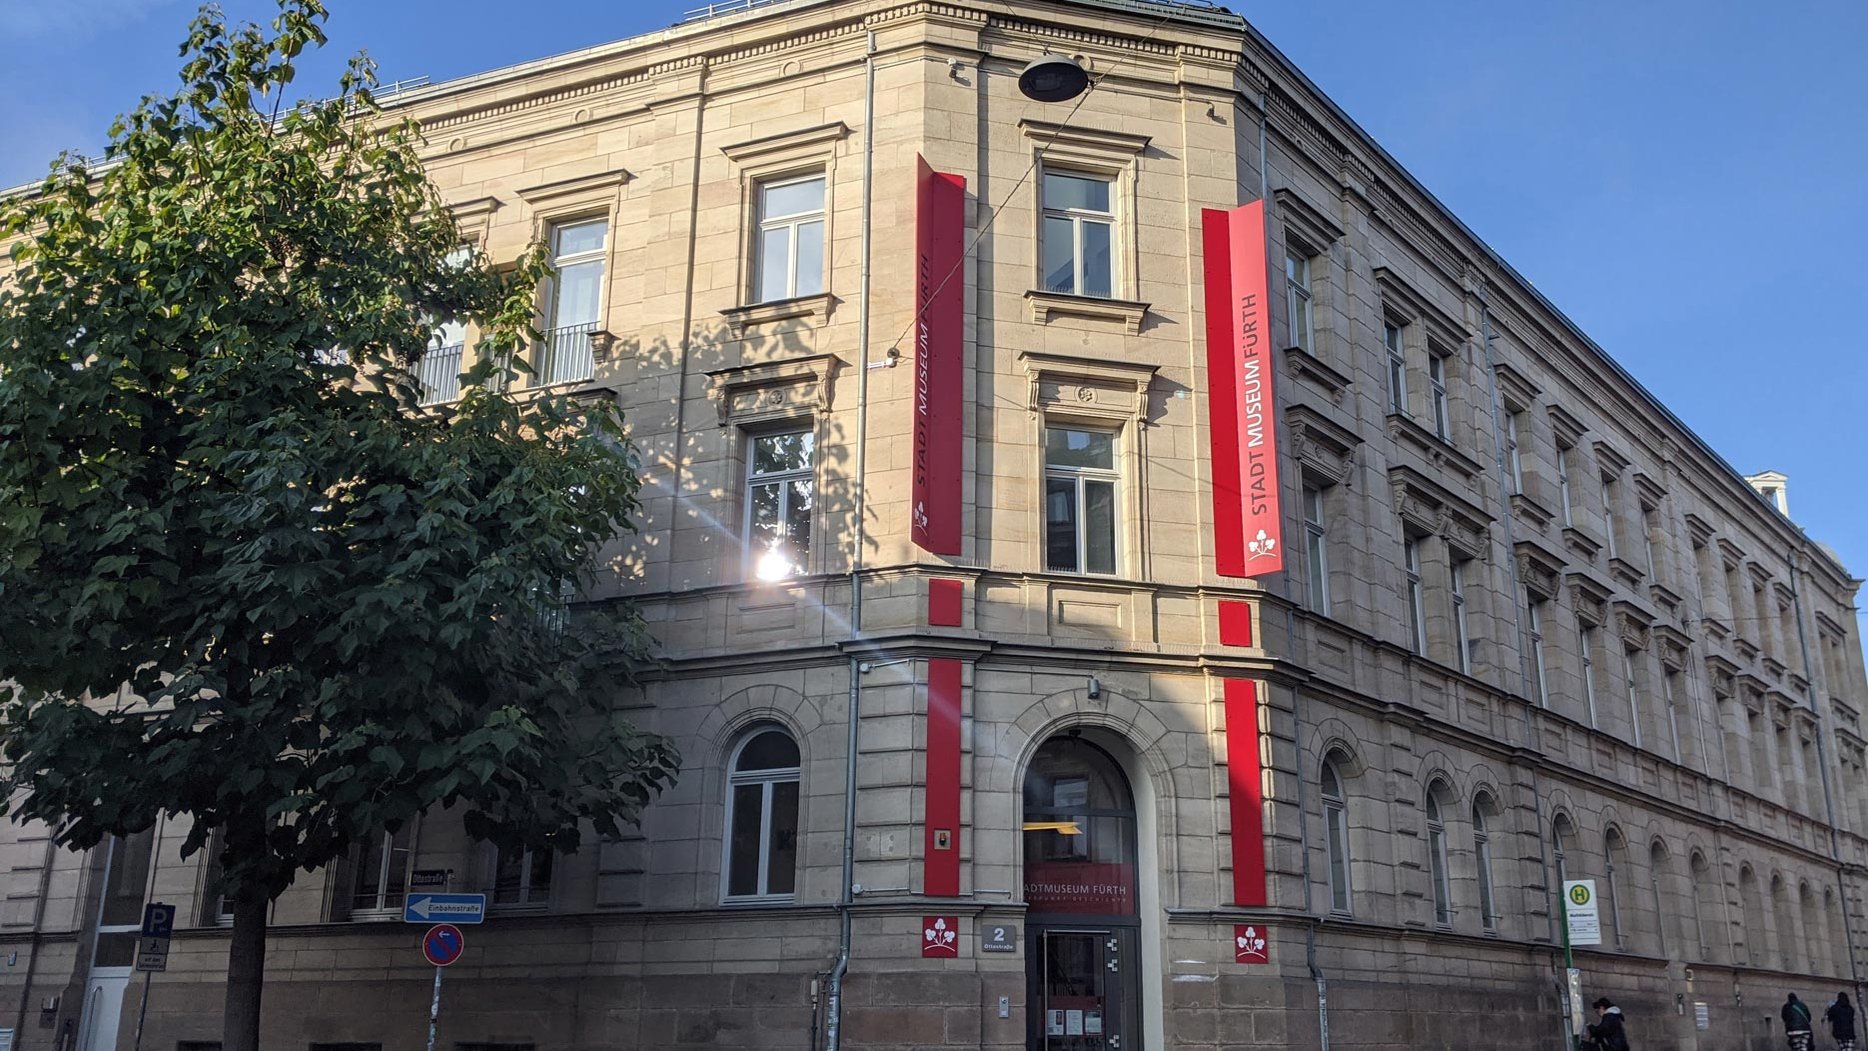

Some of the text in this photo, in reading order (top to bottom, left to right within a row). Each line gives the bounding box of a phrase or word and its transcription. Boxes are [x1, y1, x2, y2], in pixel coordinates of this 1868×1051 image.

[918, 322, 929, 415] MUSEUM
[1241, 293, 1267, 515] STADT MUSEUM FÜRTH
[917, 420, 926, 487] STADT
[1093, 884, 1126, 894] FÜRTH
[1574, 889, 1585, 901] H
[428, 904, 480, 912] Einbahnstraße
[149, 908, 167, 932] P
[993, 927, 1005, 941] 2
